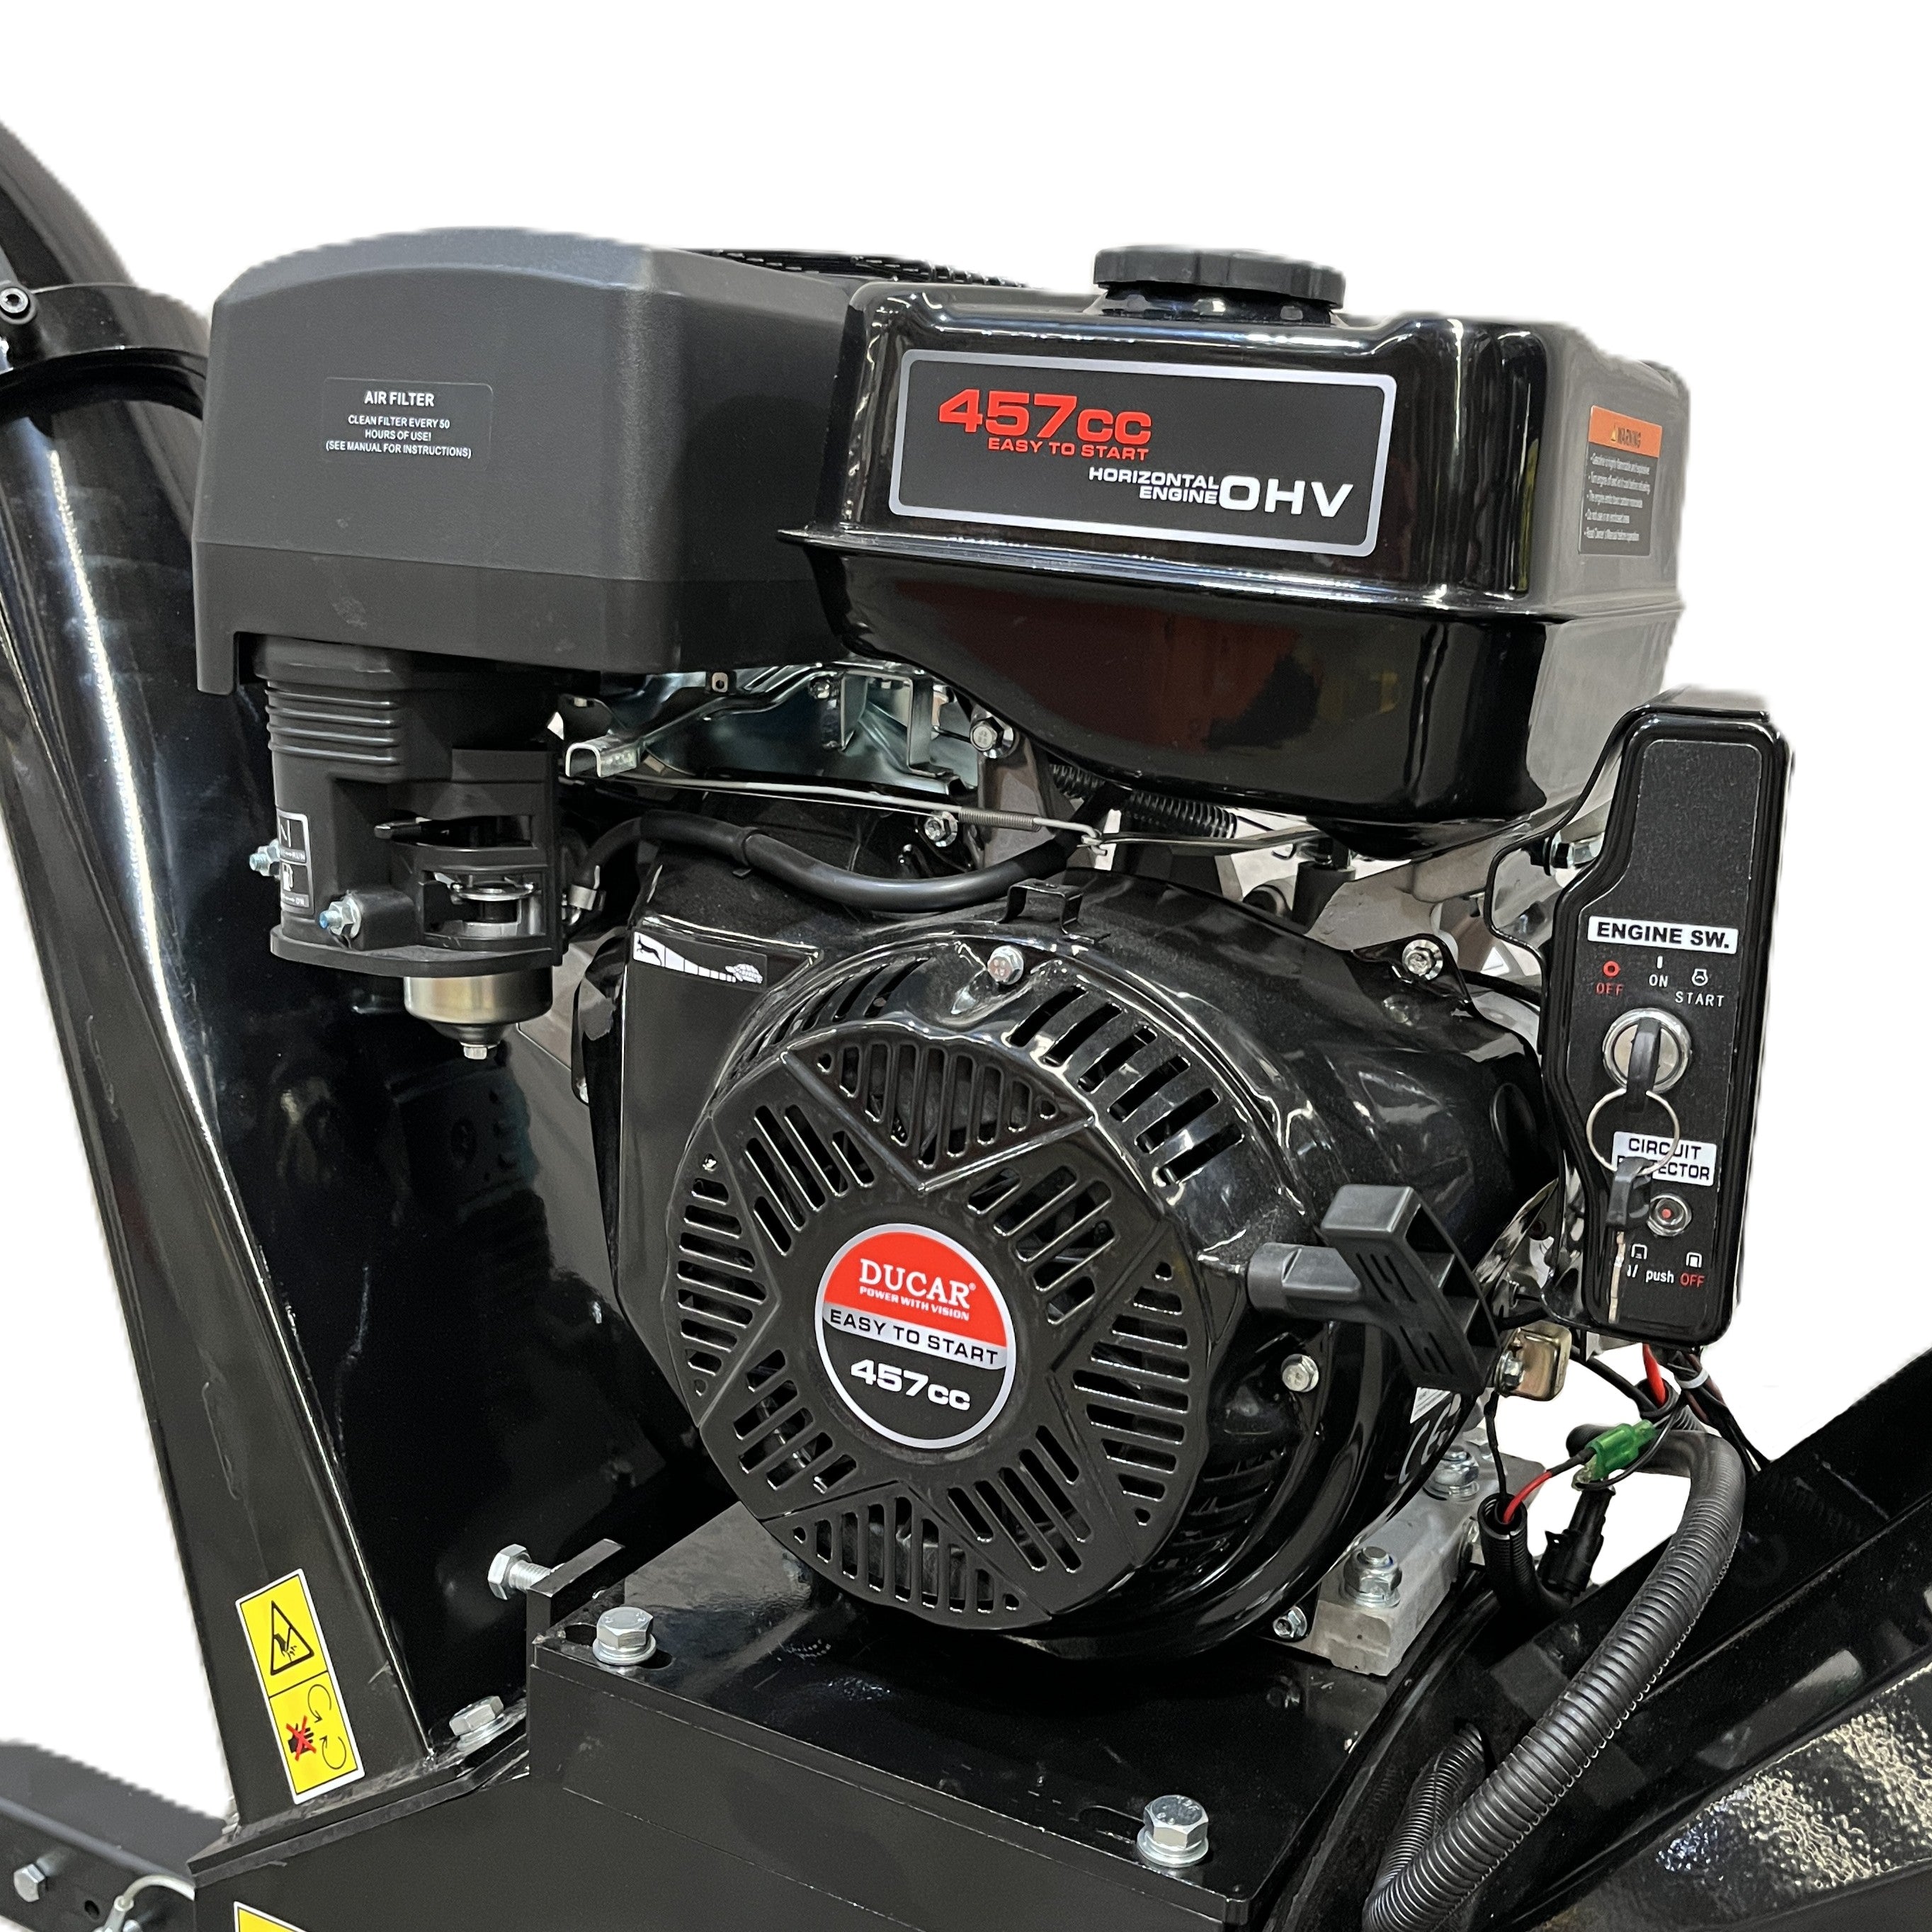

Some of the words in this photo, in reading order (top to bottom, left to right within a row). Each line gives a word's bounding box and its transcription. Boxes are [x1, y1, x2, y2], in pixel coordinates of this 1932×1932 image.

[364, 390, 387, 405] AIR
[389, 391, 435, 407] FILTER
[348, 414, 377, 425] CLEAN
[377, 416, 407, 427] FILTER
[409, 417, 438, 428] EVERY
[439, 419, 450, 429] 50
[937, 388, 1152, 446] 457cc
[365, 429, 396, 440] HOURS
[397, 430, 409, 441] OF
[410, 431, 431, 441] USE!
[325, 440, 346, 452] (SEE
[346, 441, 382, 453] MANUAL
[383, 443, 402, 454] FOR
[402, 444, 472, 459] INSTRUCTIONS)
[987, 437, 1044, 454] EASY
[1048, 441, 1076, 458] TO
[1081, 445, 1150, 462] START
[1088, 466, 1220, 491] HORIZONTAL
[1139, 486, 1218, 506] ENGINE
[1218, 475, 1354, 518] OHV
[1596, 921, 1683, 945] ENGINE
[1690, 929, 1729, 949] SW.
[1596, 982, 1625, 996] OFF
[1648, 974, 1669, 988] ON
[1674, 991, 1725, 1008] START
[1645, 1270, 1674, 1284] push
[1679, 1272, 1705, 1288] OFF
[859, 1285, 899, 1304] POWER
[900, 1295, 929, 1312] WITH
[931, 1304, 970, 1322] VISION
[829, 1308, 886, 1335] EASY
[892, 1325, 919, 1345] TO
[928, 1335, 999, 1365] START
[850, 1358, 971, 1411] 457cc
